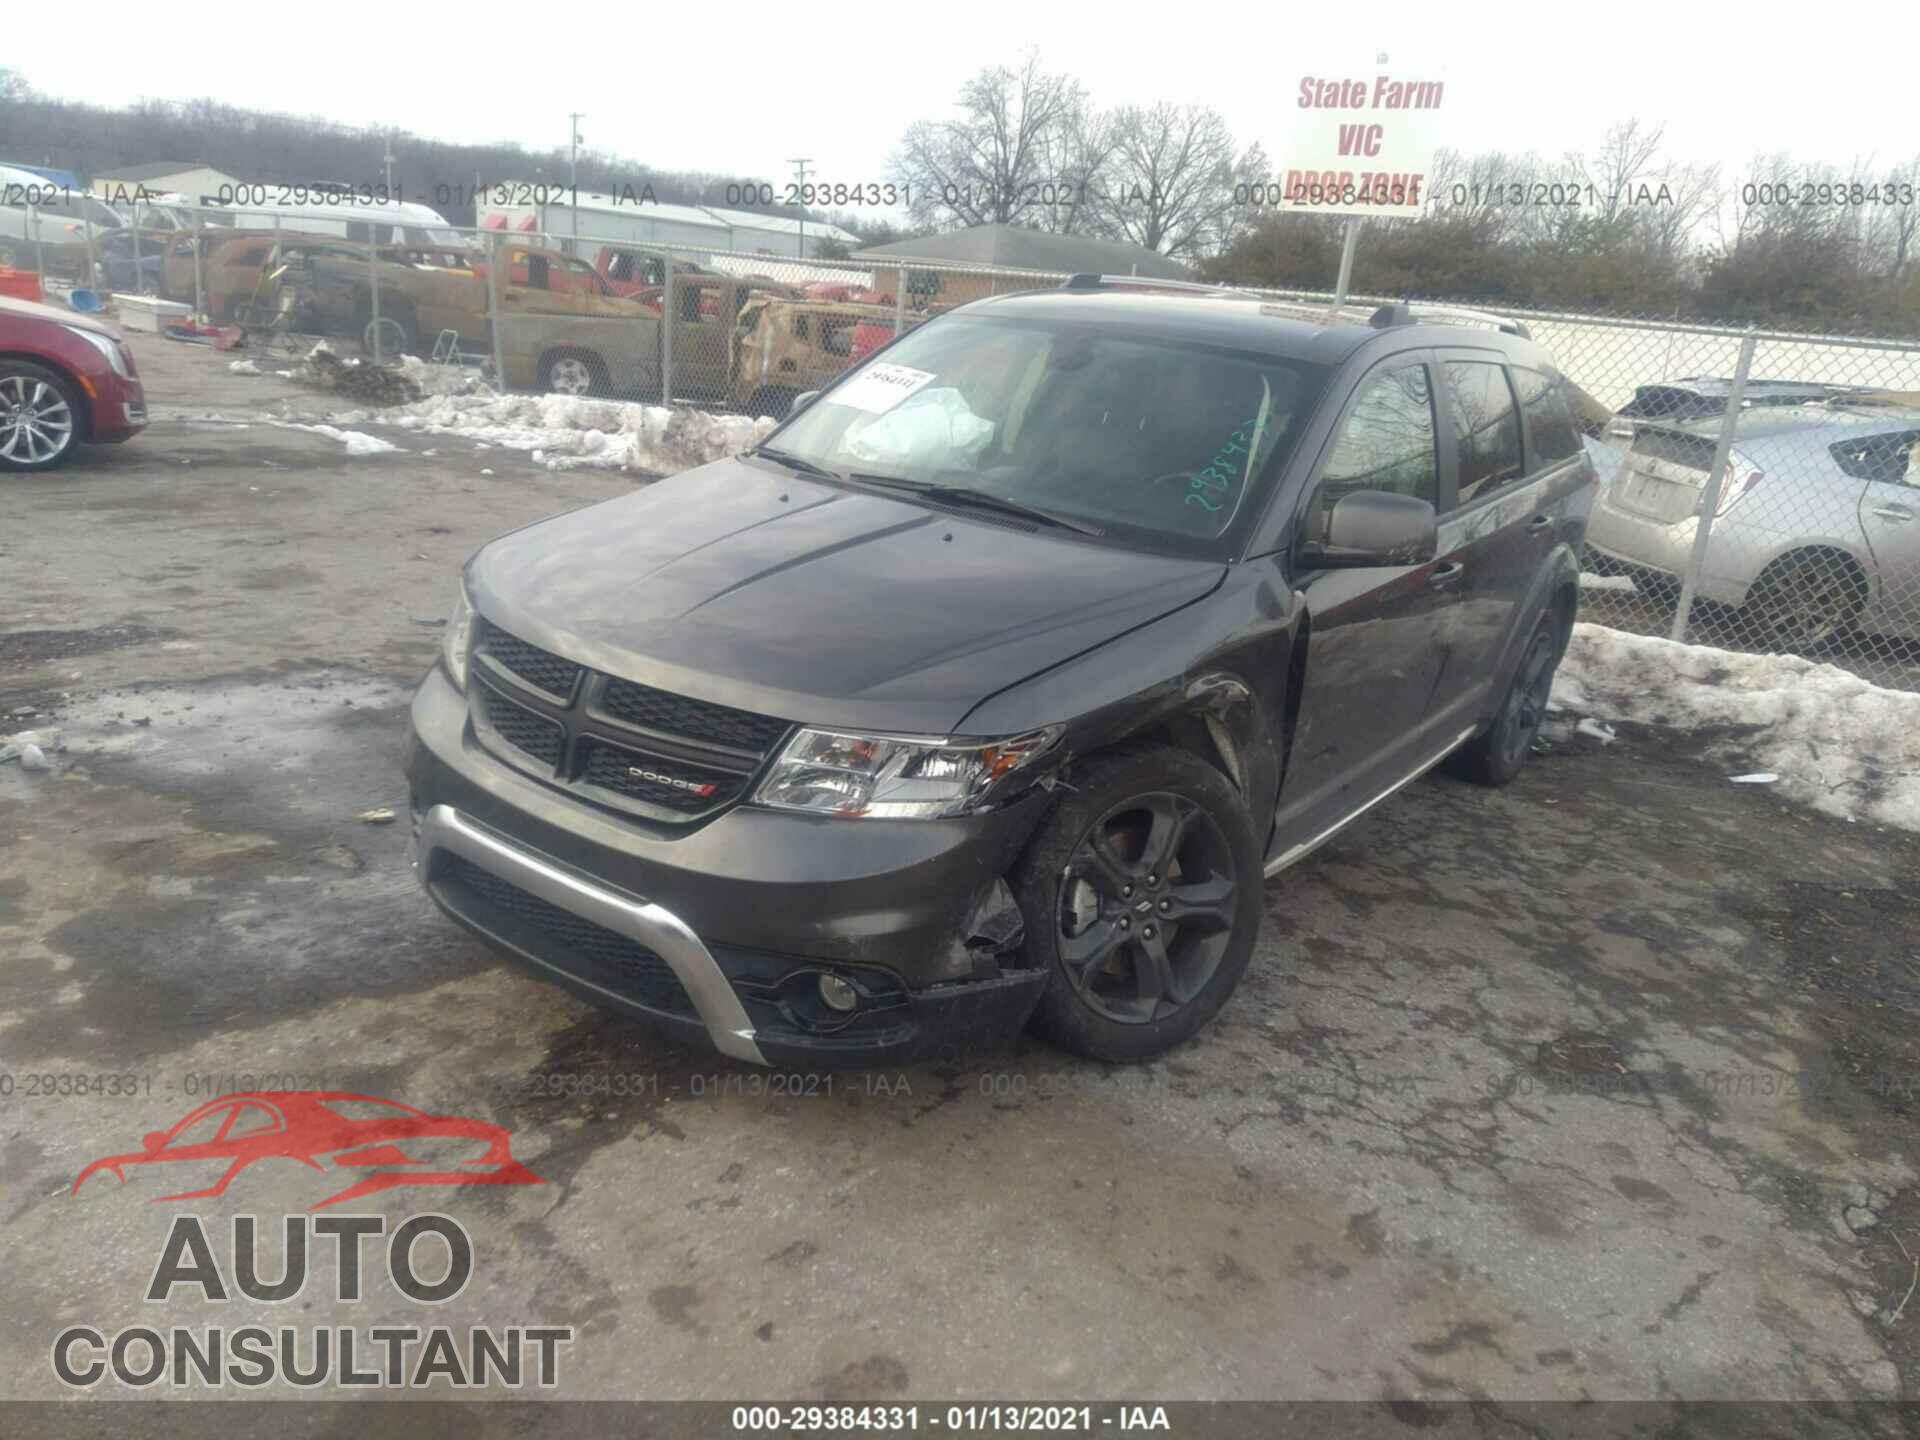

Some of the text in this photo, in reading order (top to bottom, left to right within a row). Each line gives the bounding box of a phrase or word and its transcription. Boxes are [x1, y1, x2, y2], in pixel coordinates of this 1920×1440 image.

[1297, 76, 1444, 109] State Farm
[1338, 124, 1383, 157] VIC
[1285, 169, 1425, 206] DROP ZONE
[628, 765, 703, 794] DODGE
